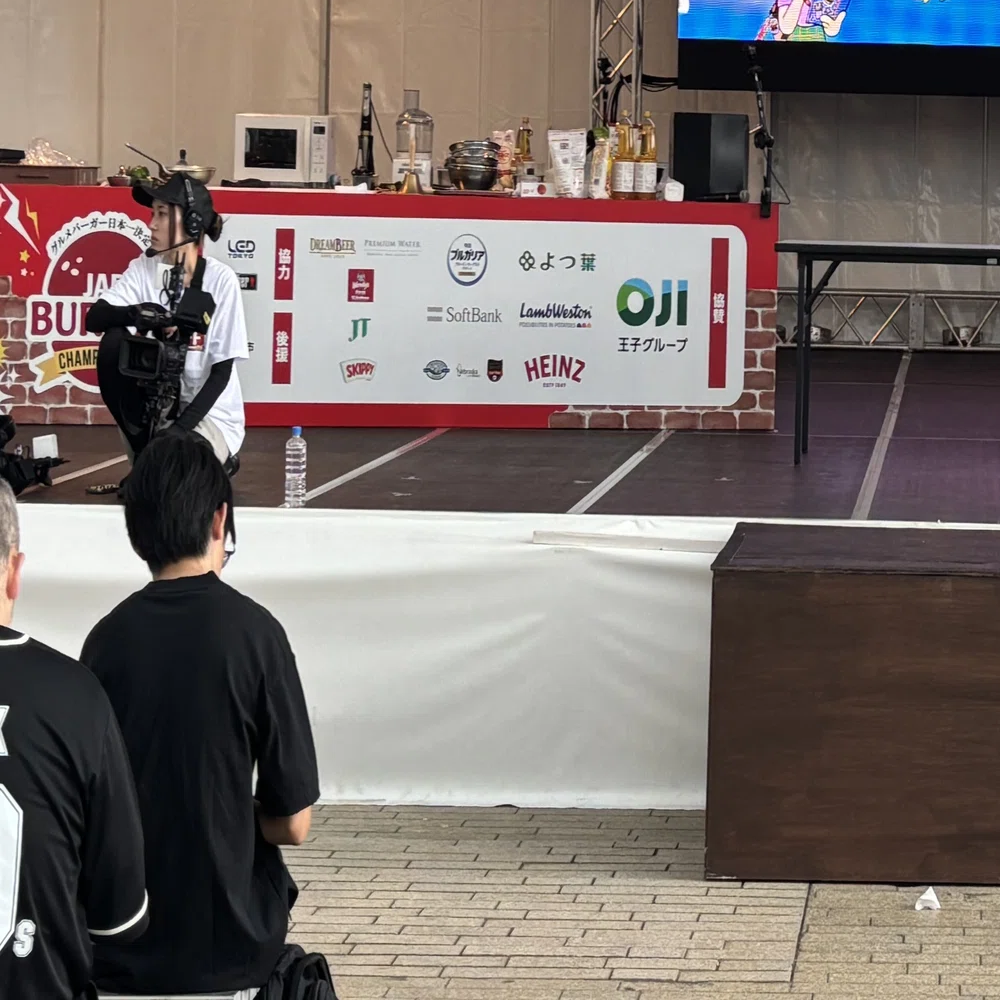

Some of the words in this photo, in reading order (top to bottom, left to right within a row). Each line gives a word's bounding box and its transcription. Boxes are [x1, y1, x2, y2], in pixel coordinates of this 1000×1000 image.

[50, 217, 151, 255] グルメバーガー日本一決定
[227, 240, 256, 253] LED
[278, 248, 292, 280] 協力
[450, 249, 485, 261] ブルガリア
[540, 252, 597, 271] よつ葉
[616, 277, 689, 327] OJI
[712, 293, 726, 324] 協賛
[446, 306, 502, 323] SoftBank
[348, 318, 371, 342] JT
[275, 331, 290, 363] 後援
[617, 337, 689, 353] 王子グループ
[346, 362, 375, 378] SKIPPY
[524, 354, 586, 383] HEINZ
